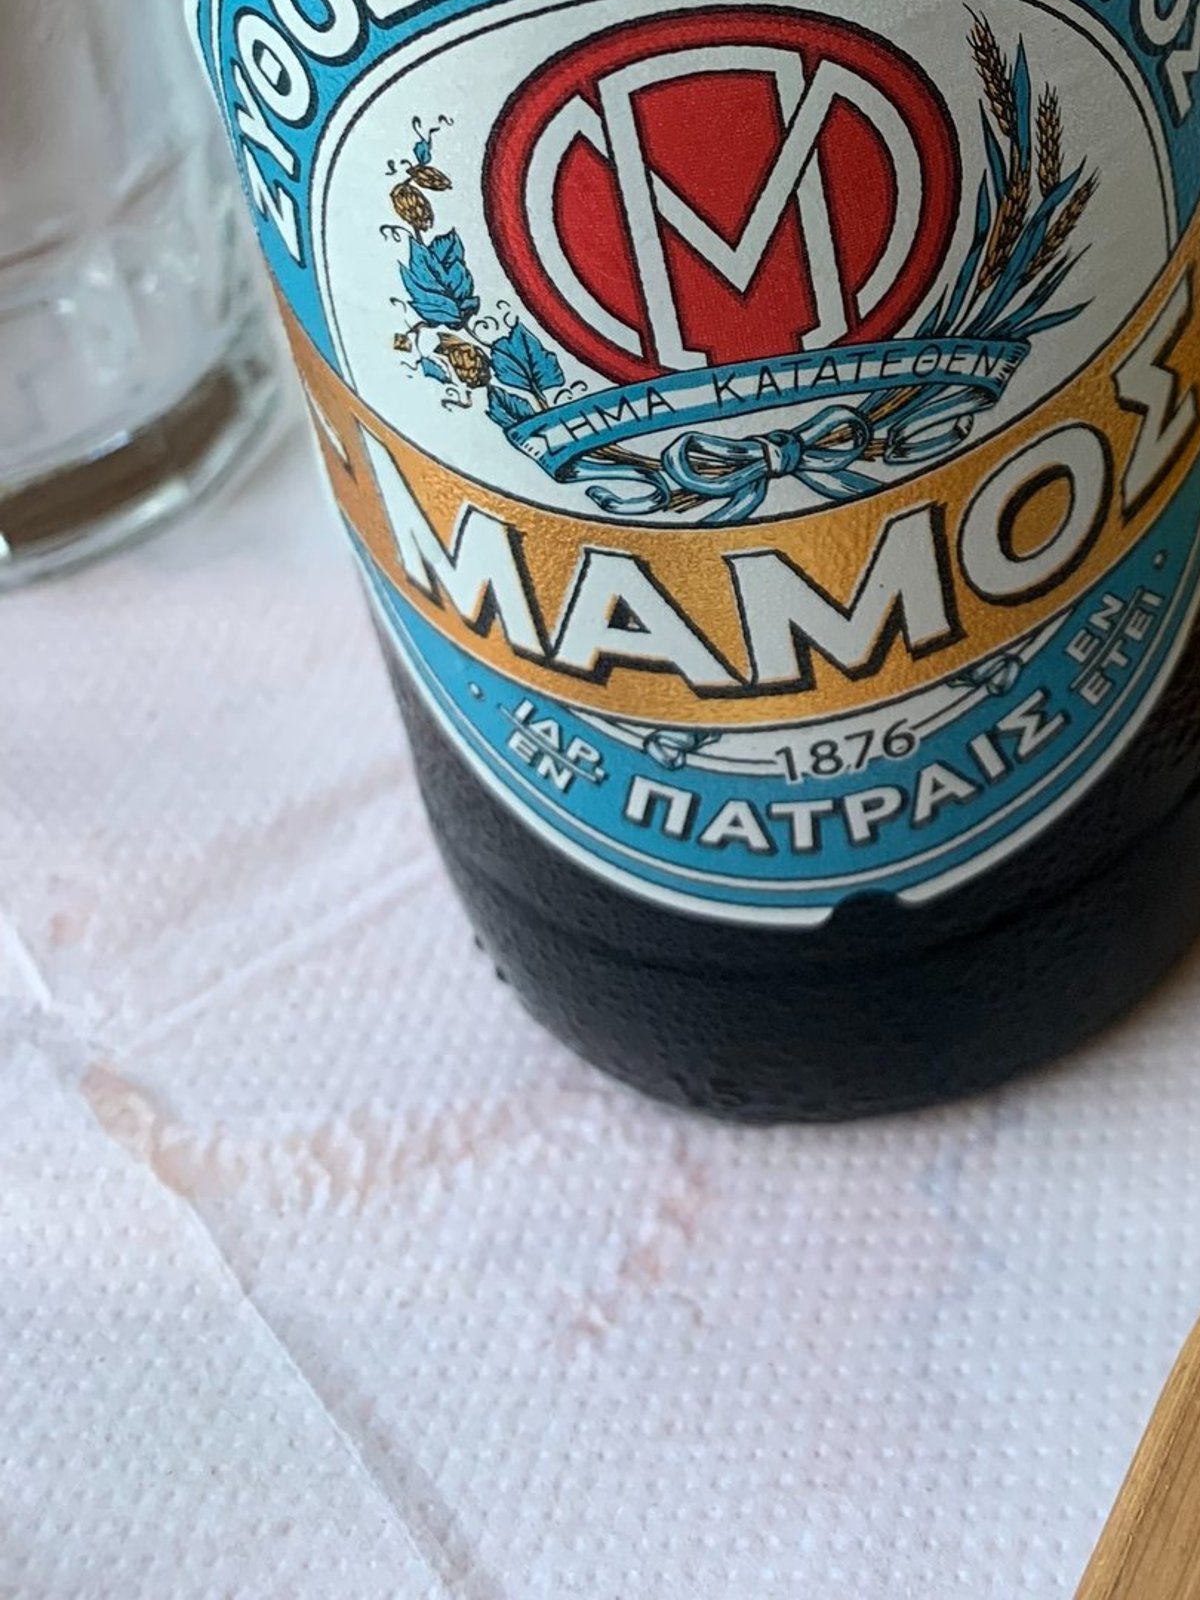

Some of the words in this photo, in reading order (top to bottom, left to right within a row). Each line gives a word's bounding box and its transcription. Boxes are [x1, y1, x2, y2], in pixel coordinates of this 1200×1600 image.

[529, 387, 678, 456] ΣΗΜΑ
[712, 343, 1007, 409] ΚΑΤΑΤΕΘΕΝ
[353, 264, 1200, 702] ΜΑΜΟΣ
[1064, 592, 1125, 664] ΕΝ
[507, 729, 573, 793] ΕΝ
[623, 689, 1070, 856] ΠΑΤΡΑΙΣ
[775, 717, 920, 784] 1876
